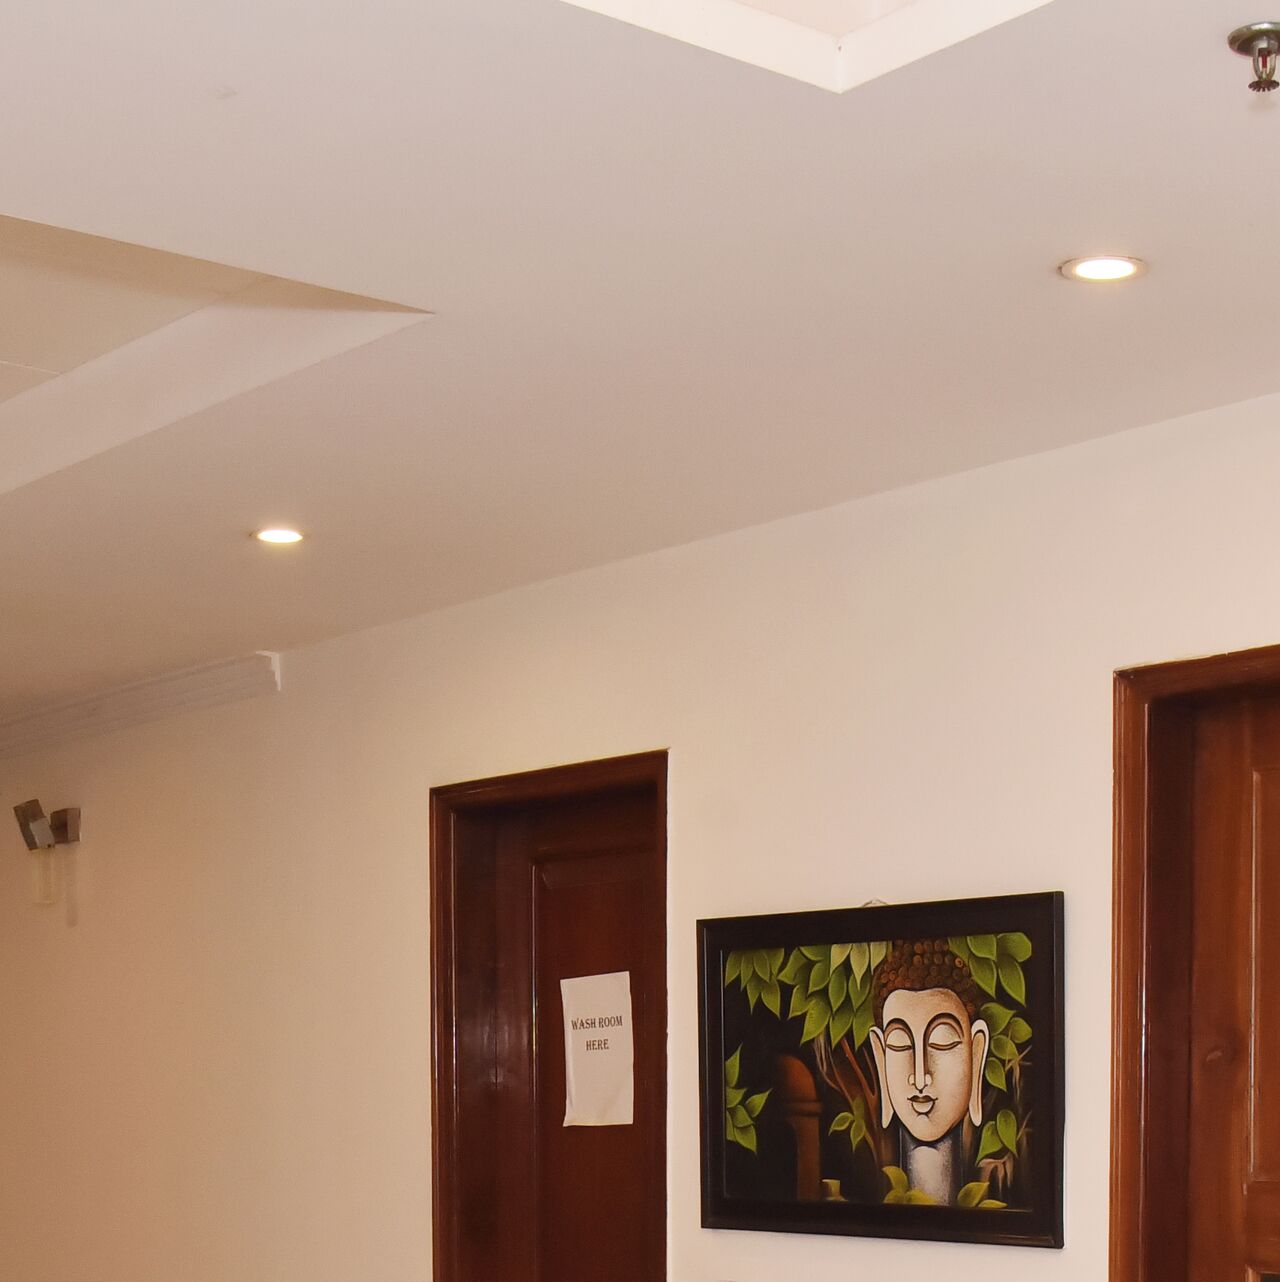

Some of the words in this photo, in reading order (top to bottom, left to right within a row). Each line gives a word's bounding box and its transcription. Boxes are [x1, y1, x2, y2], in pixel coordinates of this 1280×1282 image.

[571, 1017, 597, 1030] WASH
[598, 1015, 623, 1028] ROOM
[586, 1039, 609, 1051] HERE
